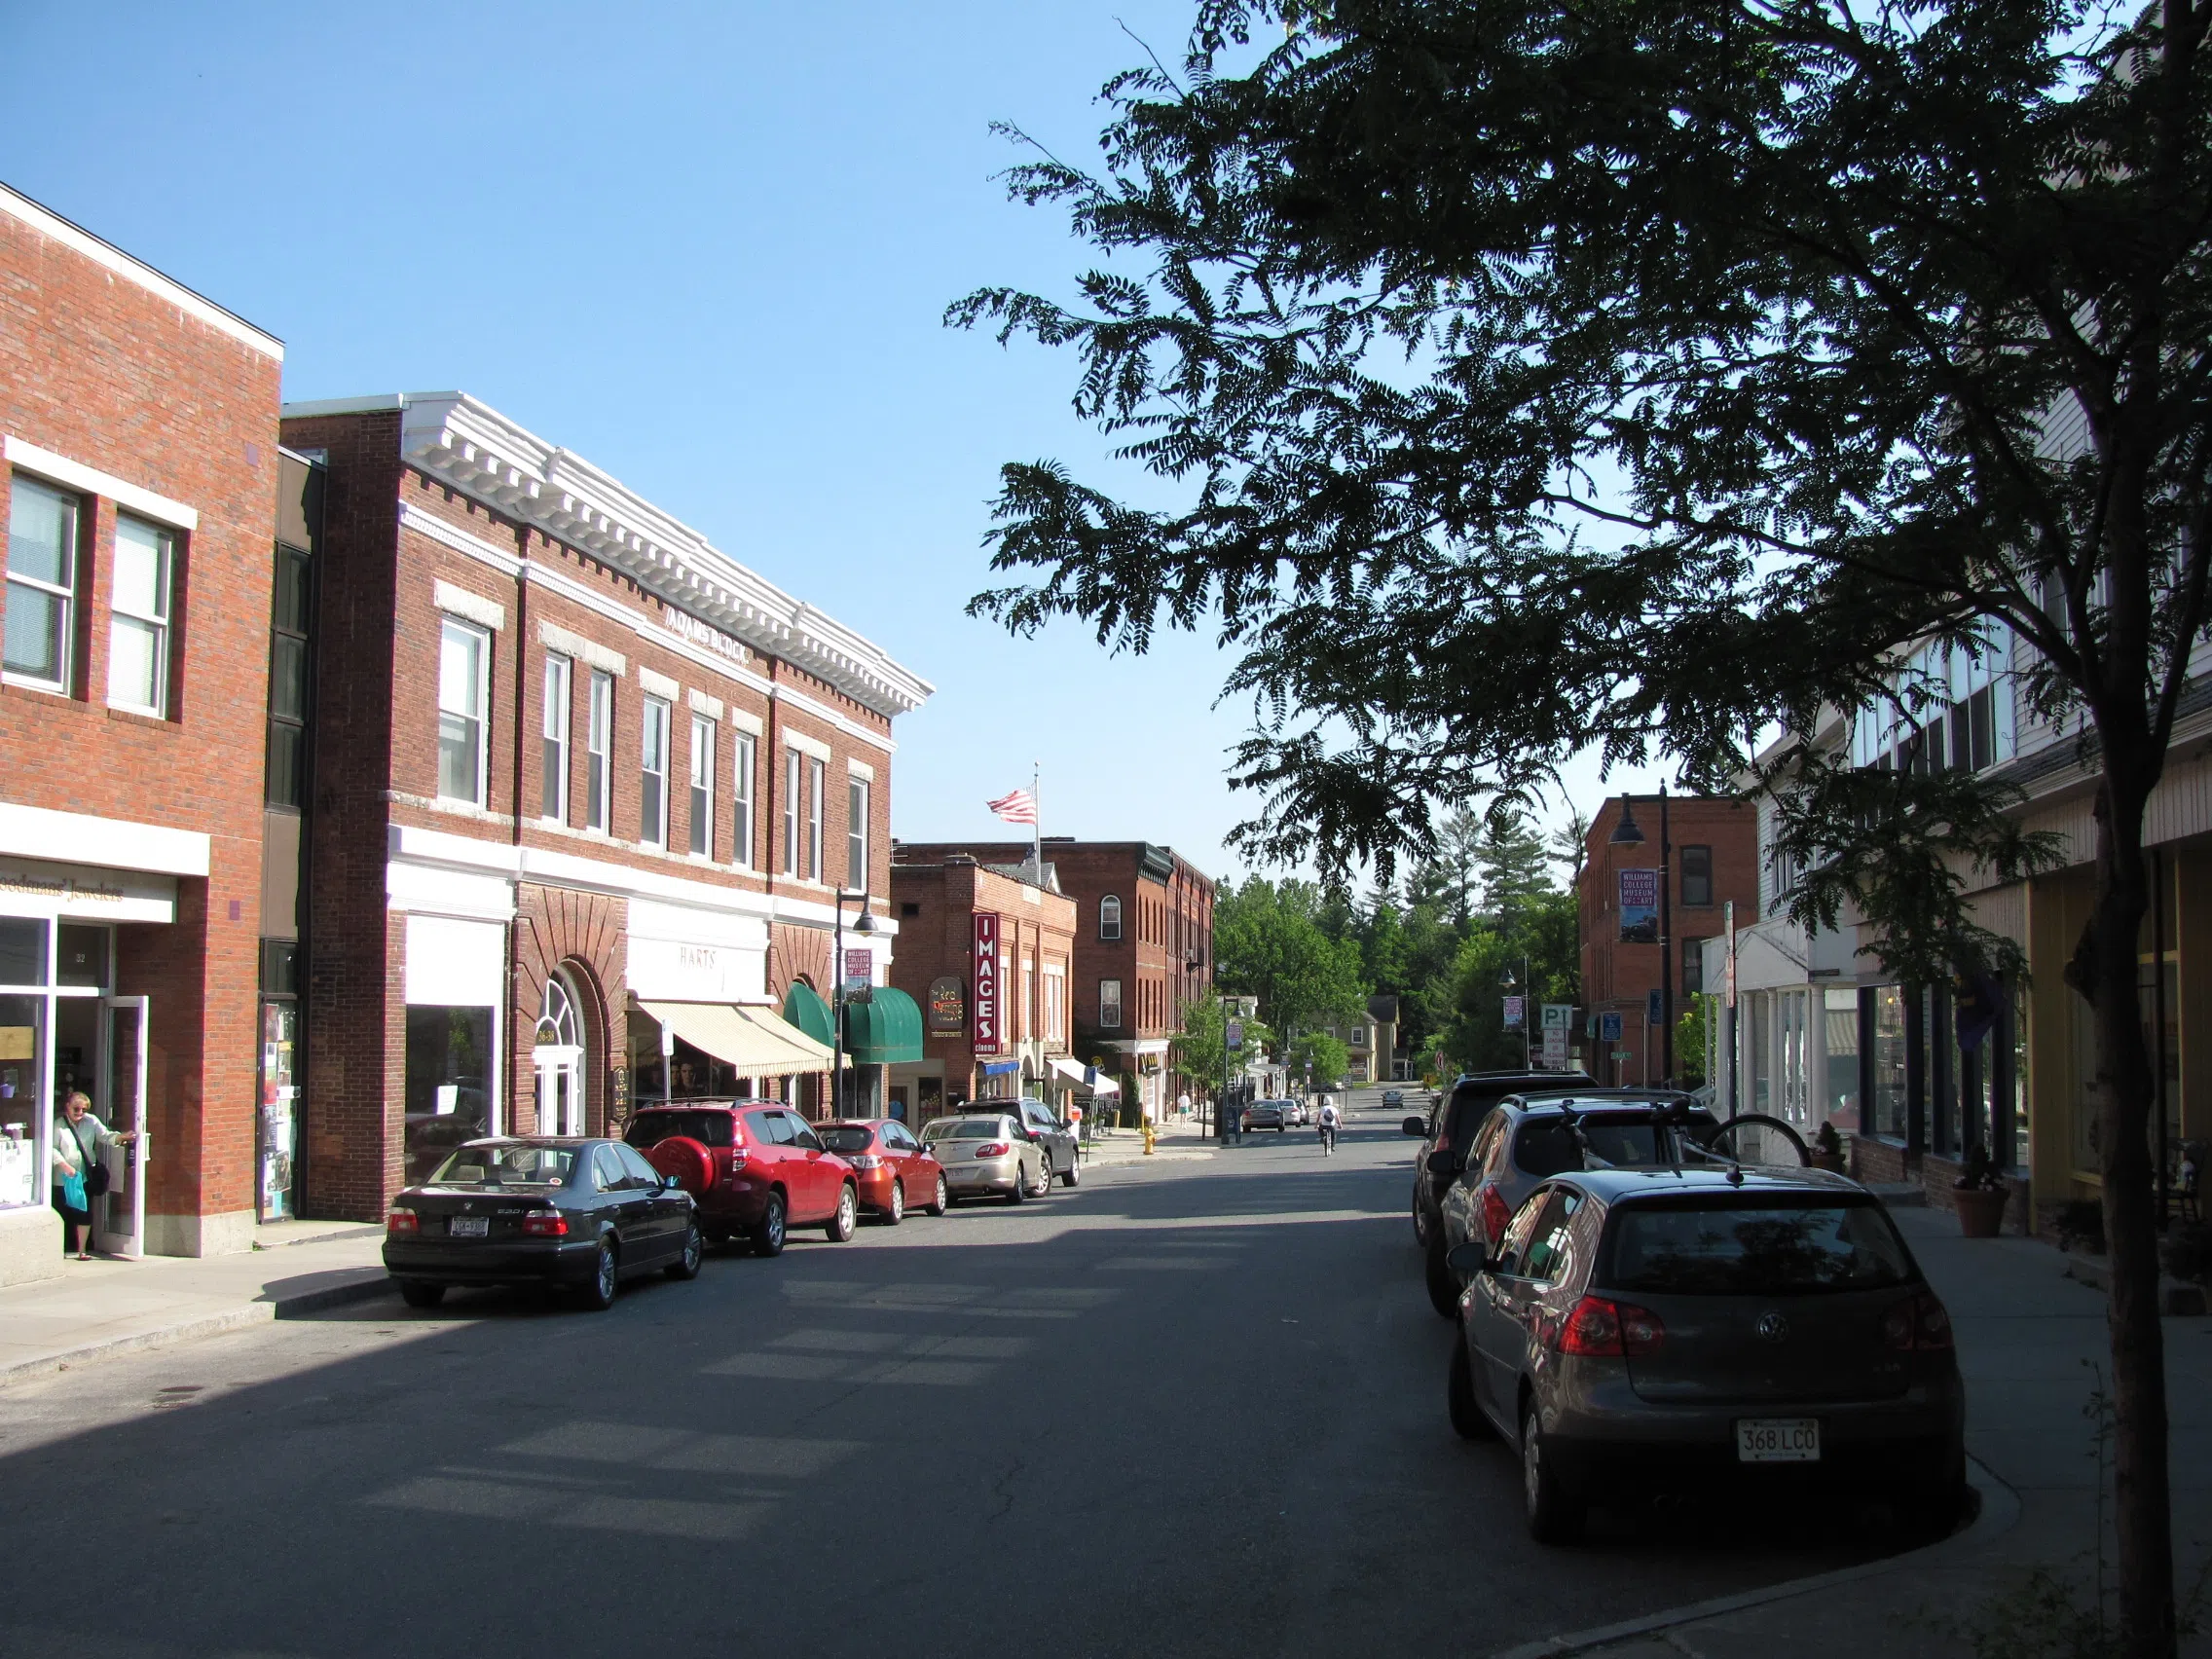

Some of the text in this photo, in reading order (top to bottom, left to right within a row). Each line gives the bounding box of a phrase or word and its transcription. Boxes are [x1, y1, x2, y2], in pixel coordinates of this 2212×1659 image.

[665, 607, 709, 644] ADAMS
[67, 878, 125, 903] Jewelers
[76, 953, 86, 963] 32
[977, 919, 994, 1039] IMAGES
[940, 985, 956, 1000] Red
[1545, 1009, 1558, 1025] P
[975, 1043, 996, 1052] cinema
[1743, 1428, 1778, 1451] 368
